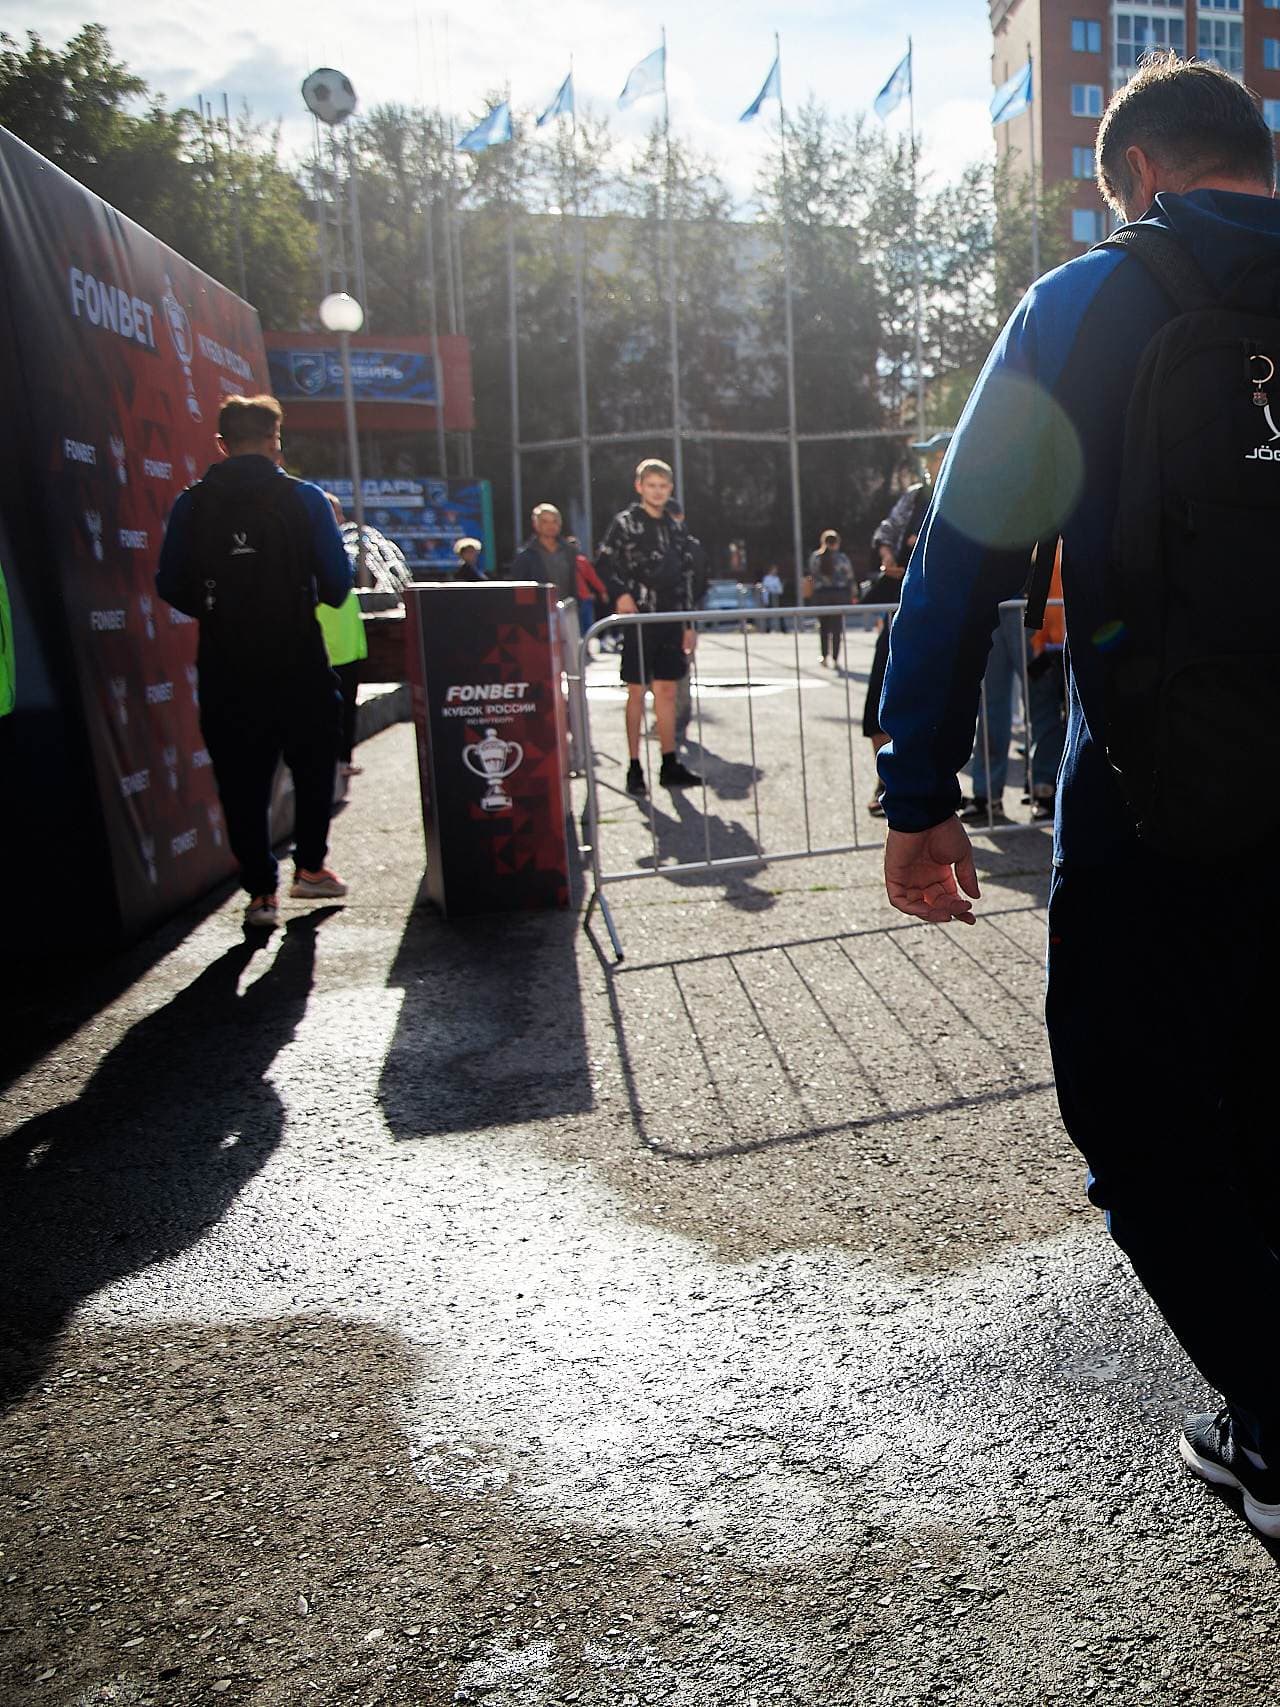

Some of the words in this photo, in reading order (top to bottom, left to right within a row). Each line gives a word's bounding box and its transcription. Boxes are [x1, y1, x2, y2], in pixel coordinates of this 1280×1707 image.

[70, 266, 156, 349] FONBET
[64, 438, 97, 465] FONBET
[143, 457, 173, 480] FONBET
[118, 528, 149, 550] FONBET
[91, 609, 126, 631] FONBET
[145, 681, 174, 704] FONBET
[446, 682, 530, 702] FONBET
[442, 706, 483, 718] КУБОК
[485, 703, 536, 715] РОССИИ
[120, 768, 151, 798] FONBET
[169, 827, 198, 858] FONBET
